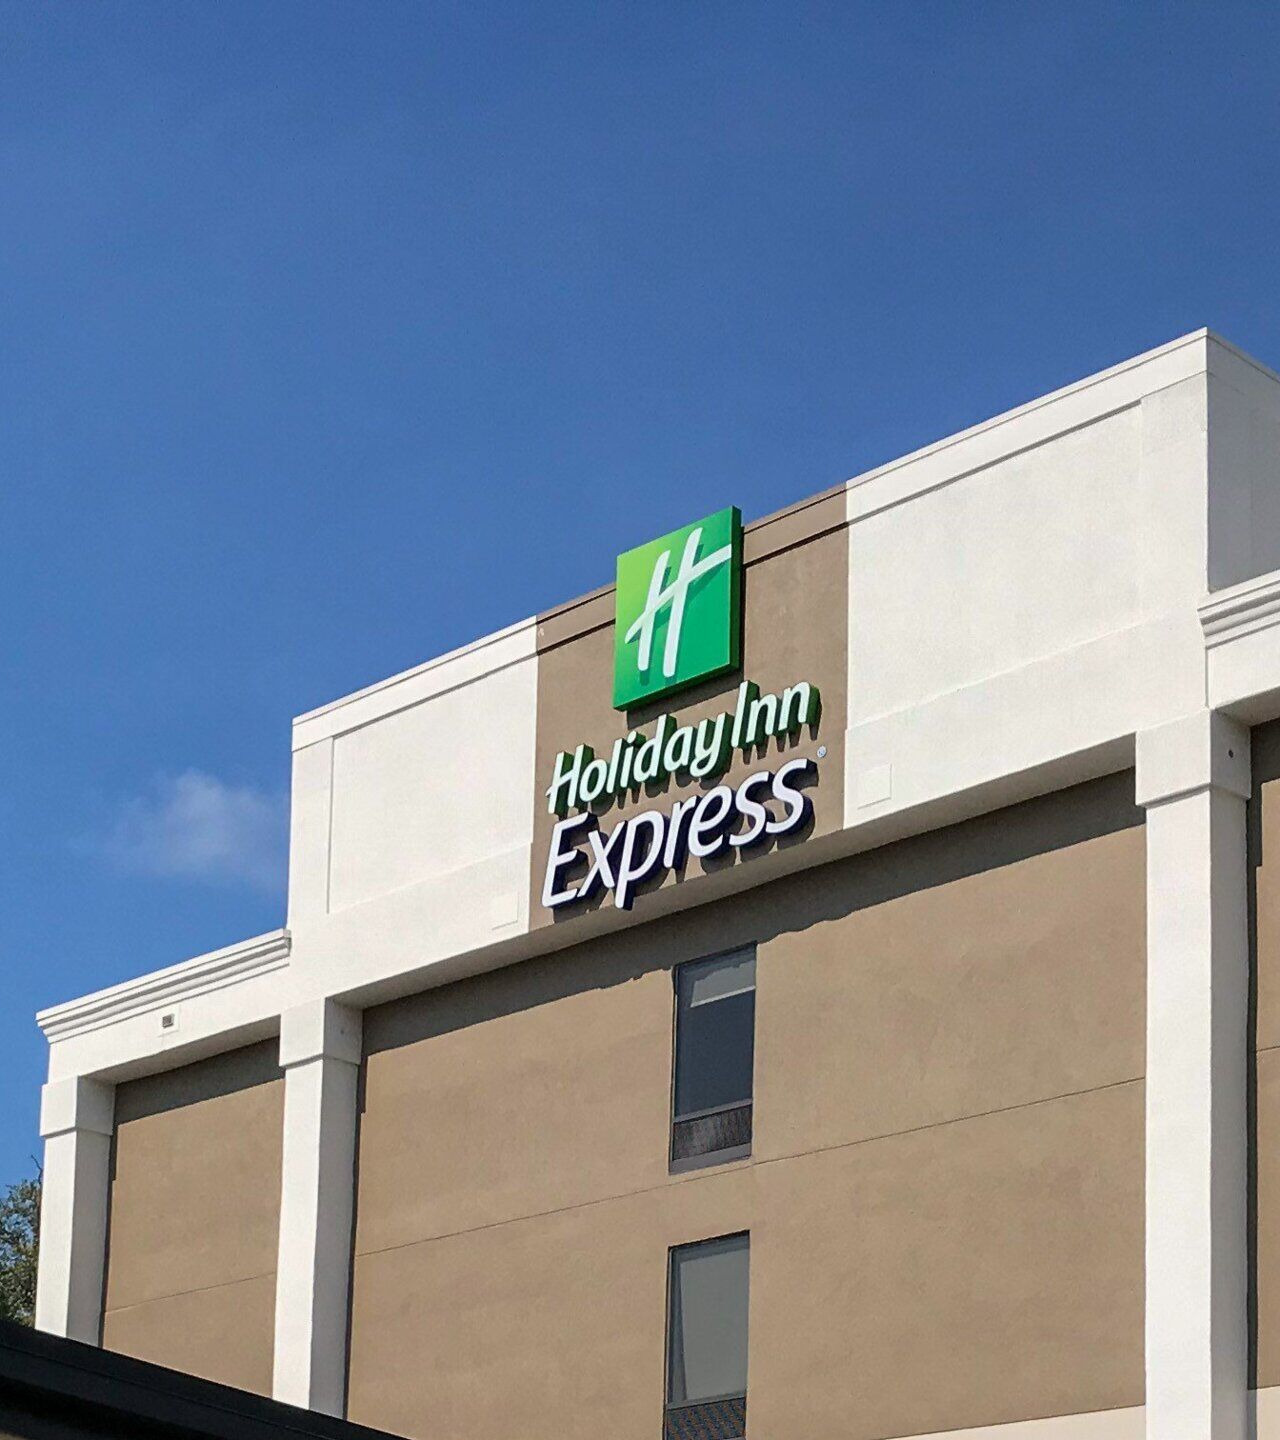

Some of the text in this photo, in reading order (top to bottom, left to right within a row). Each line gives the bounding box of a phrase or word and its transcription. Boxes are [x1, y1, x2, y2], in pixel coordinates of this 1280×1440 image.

[624, 527, 732, 678] H
[546, 680, 813, 814] Holiday Inn
[541, 758, 809, 909] Express
